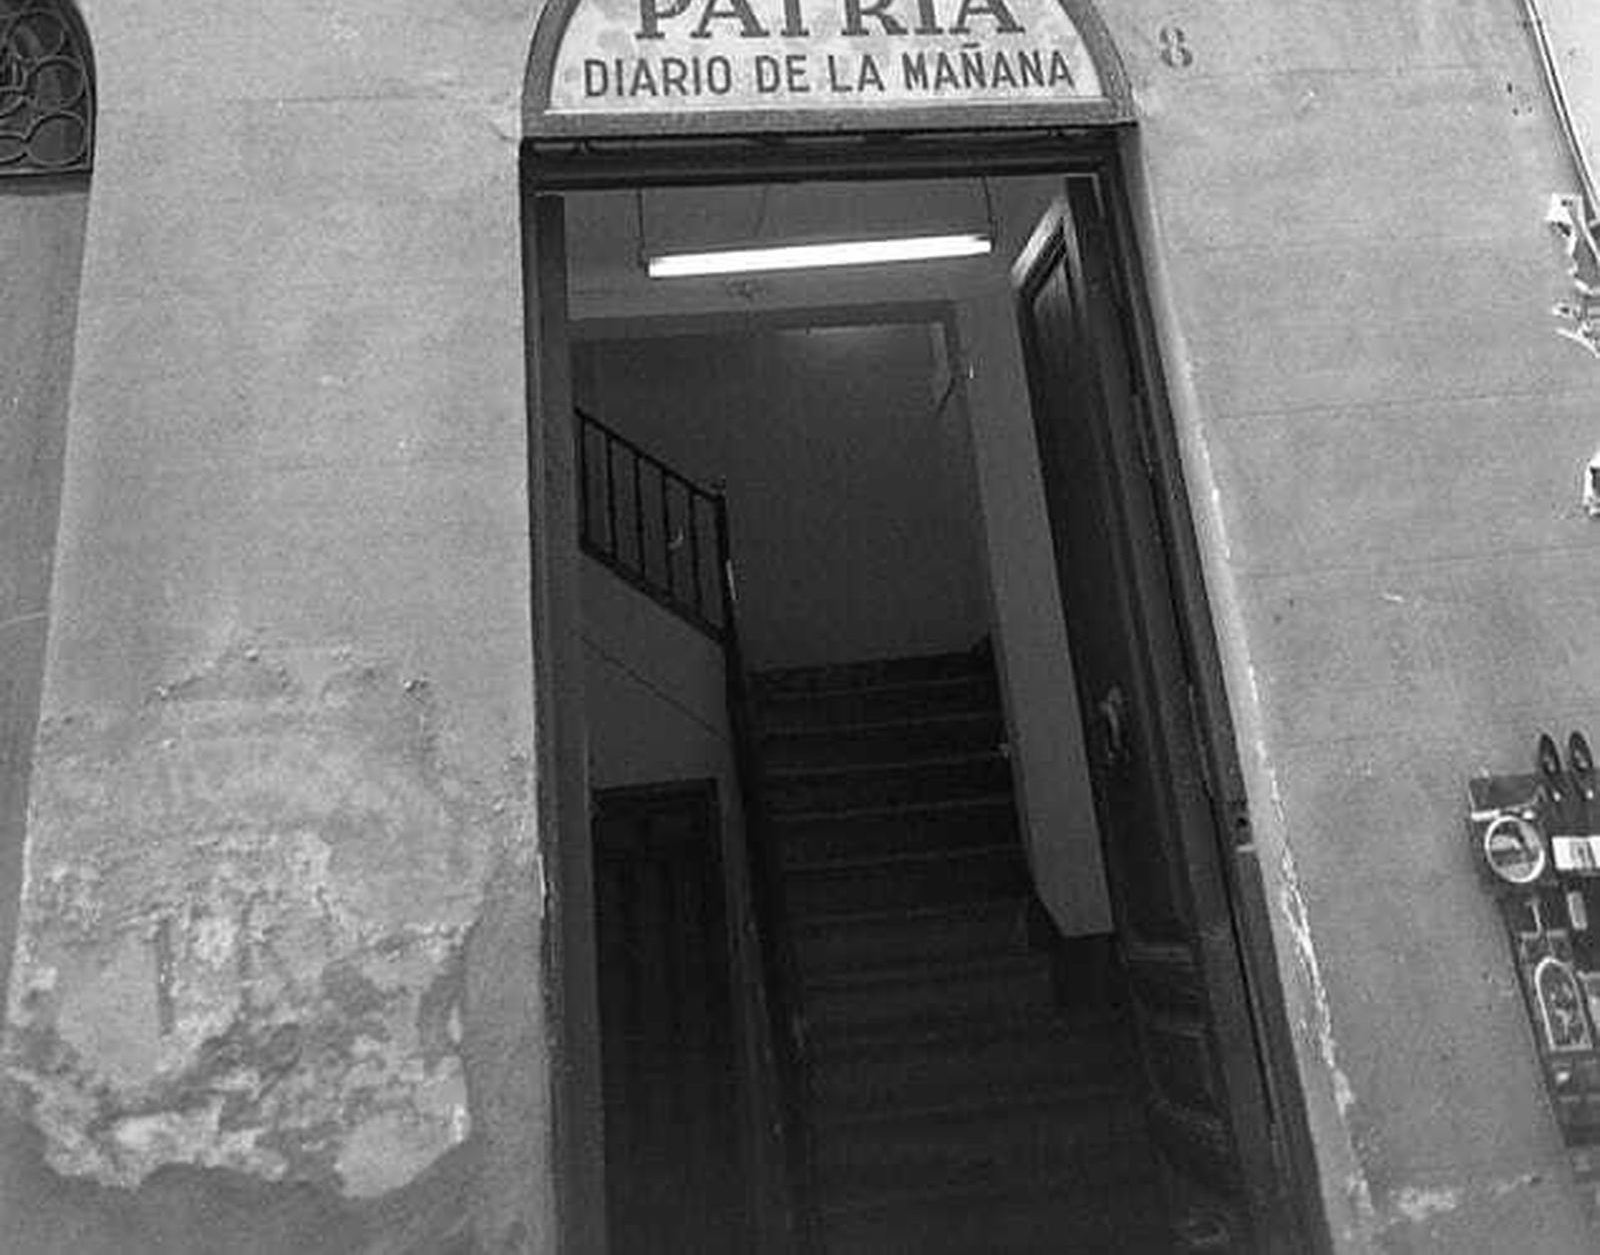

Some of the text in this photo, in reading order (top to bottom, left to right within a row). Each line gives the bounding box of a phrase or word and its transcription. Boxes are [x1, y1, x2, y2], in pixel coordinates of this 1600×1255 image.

[584, 42, 1074, 97] DIARIO DE LA MAÑANA
[1159, 26, 1193, 68] 8
